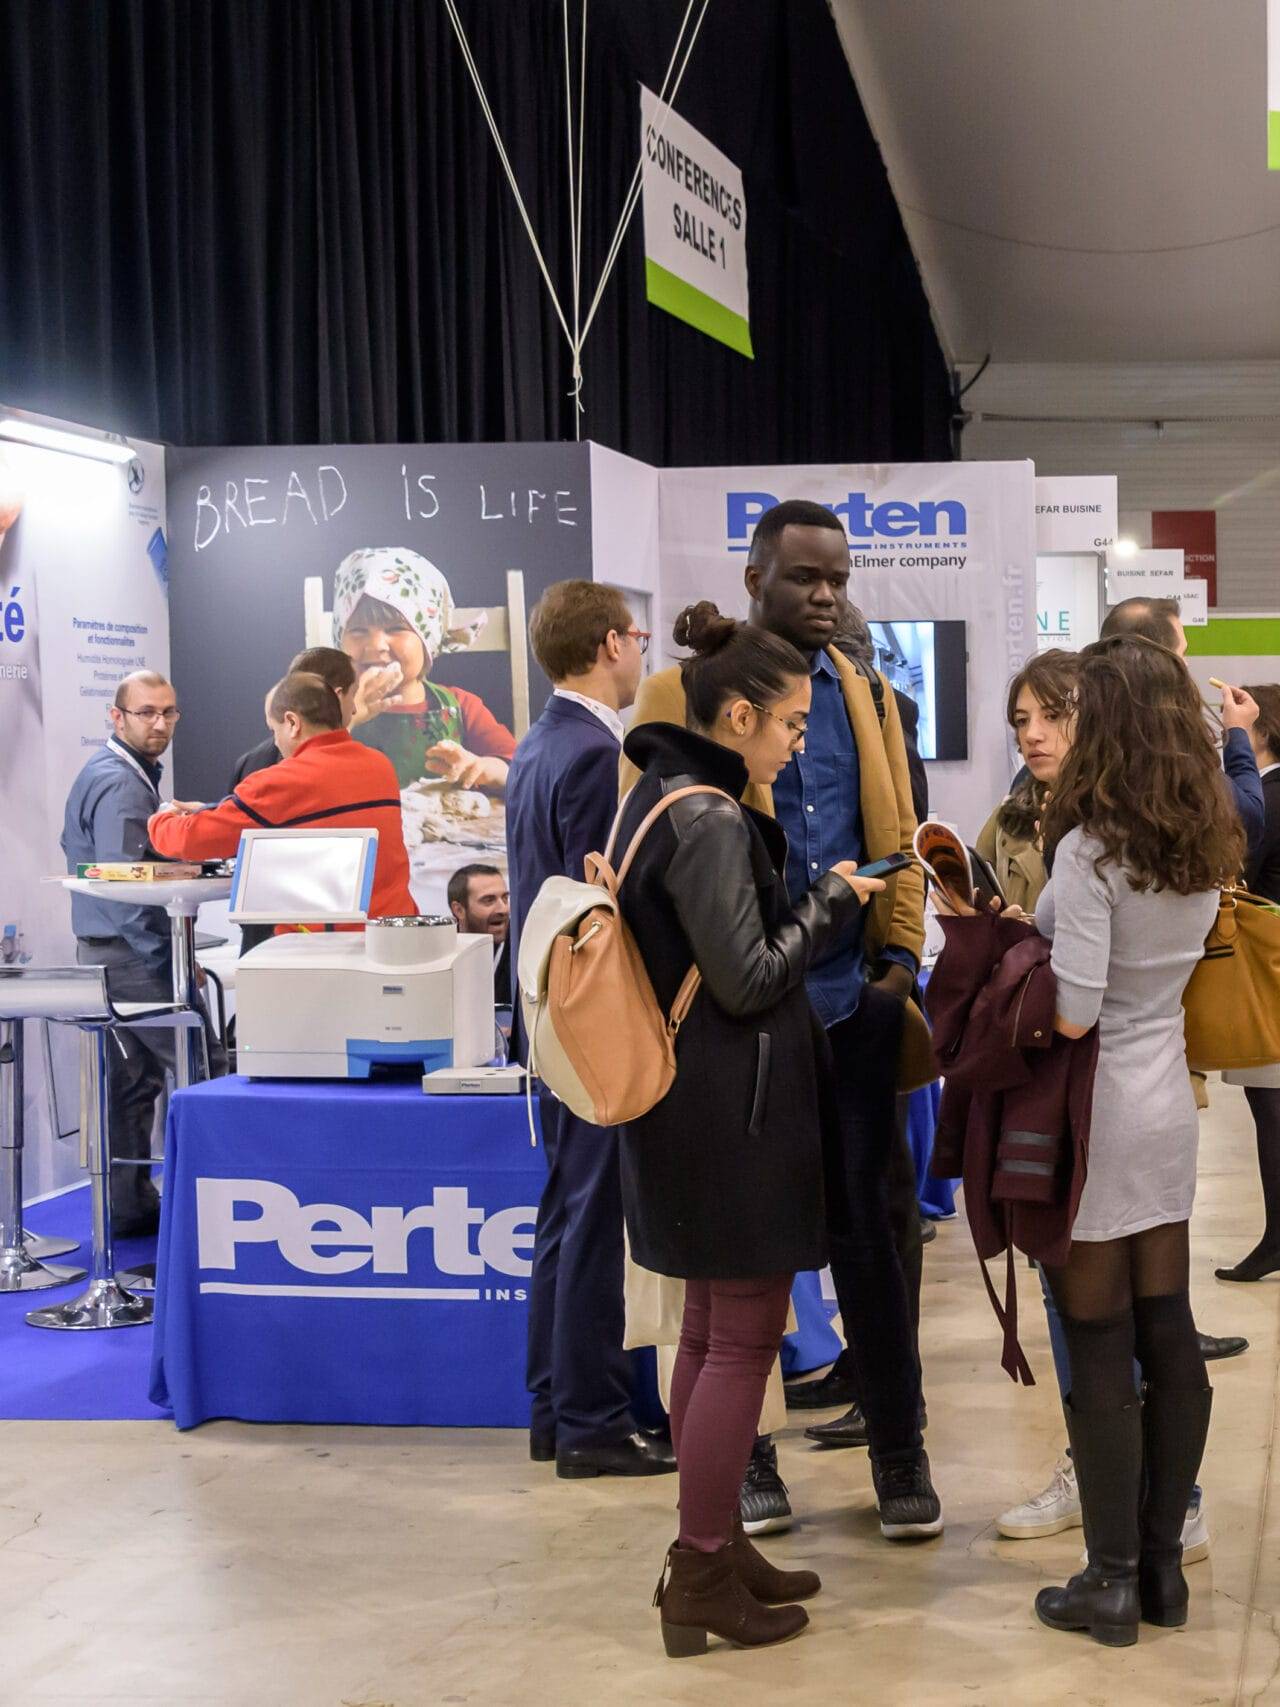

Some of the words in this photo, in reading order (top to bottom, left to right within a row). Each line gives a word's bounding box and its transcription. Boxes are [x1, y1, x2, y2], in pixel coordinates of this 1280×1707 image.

[673, 203, 717, 263] SALLE
[719, 236, 727, 269] 1
[195, 465, 348, 552] BREAD
[479, 484, 578, 526] LIFE
[726, 492, 967, 538] Pten
[1062, 504, 1102, 513] BUISINE
[873, 542, 968, 550] INSTRUMENTS
[899, 556, 967, 570] company
[0, 586, 25, 642] é
[486, 1289, 528, 1301] INS
